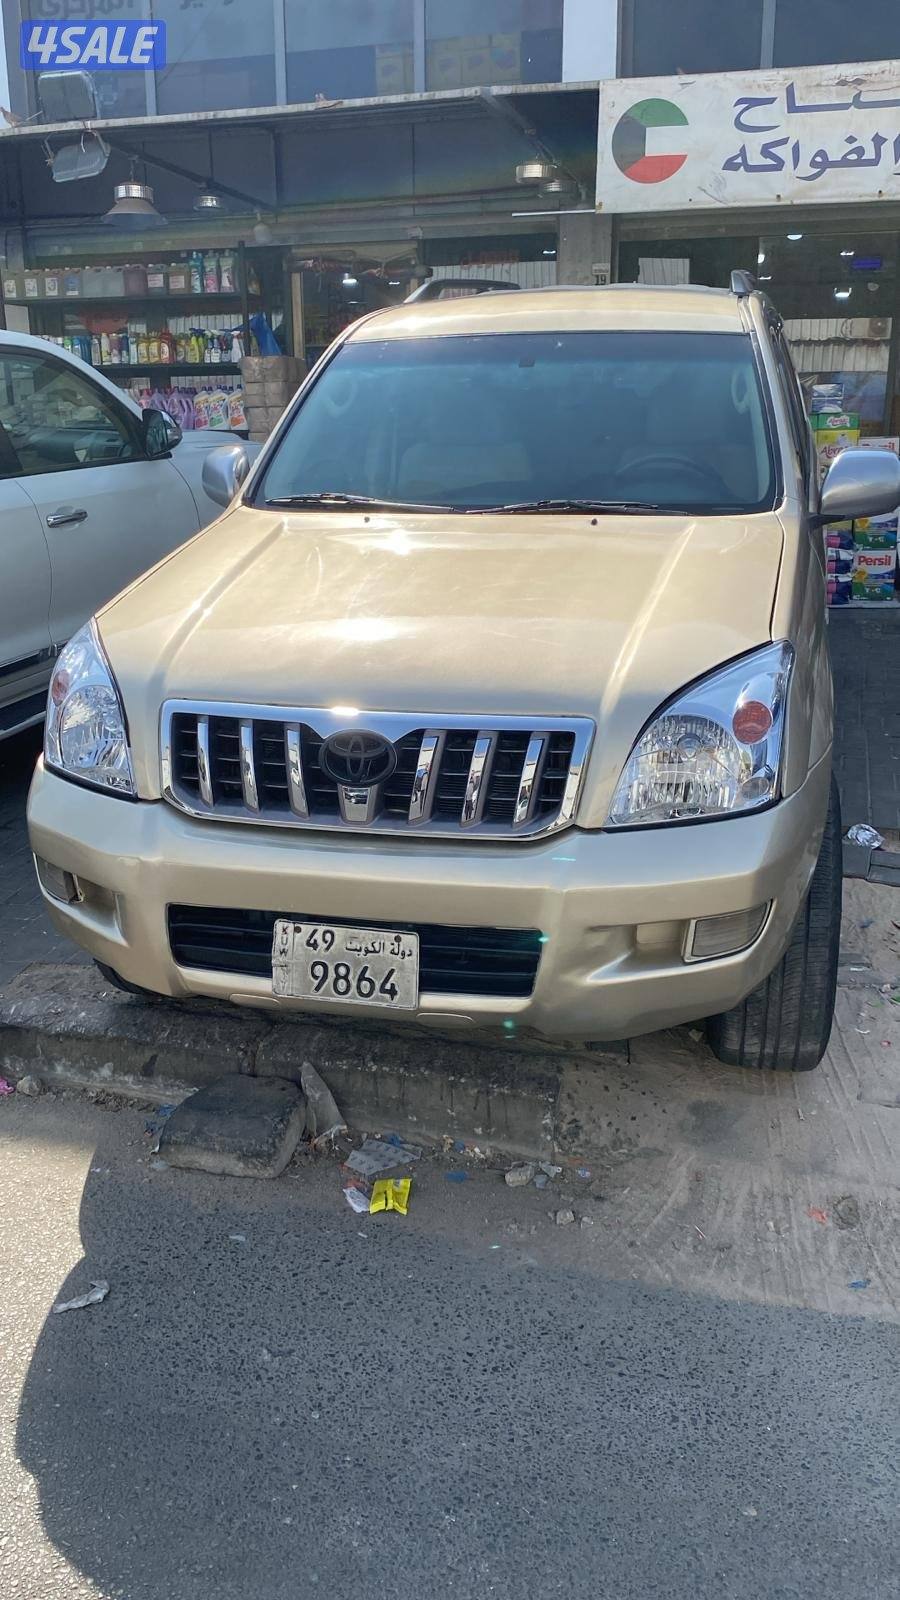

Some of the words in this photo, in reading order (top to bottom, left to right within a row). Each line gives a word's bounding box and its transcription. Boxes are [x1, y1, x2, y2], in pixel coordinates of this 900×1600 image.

[733, 77, 900, 133] تاح
[857, 553, 891, 566] Persil
[305, 928, 335, 951] 49
[345, 941, 385, 958] الكويت
[390, 941, 413, 960] دولة
[310, 960, 399, 1001] 9864
